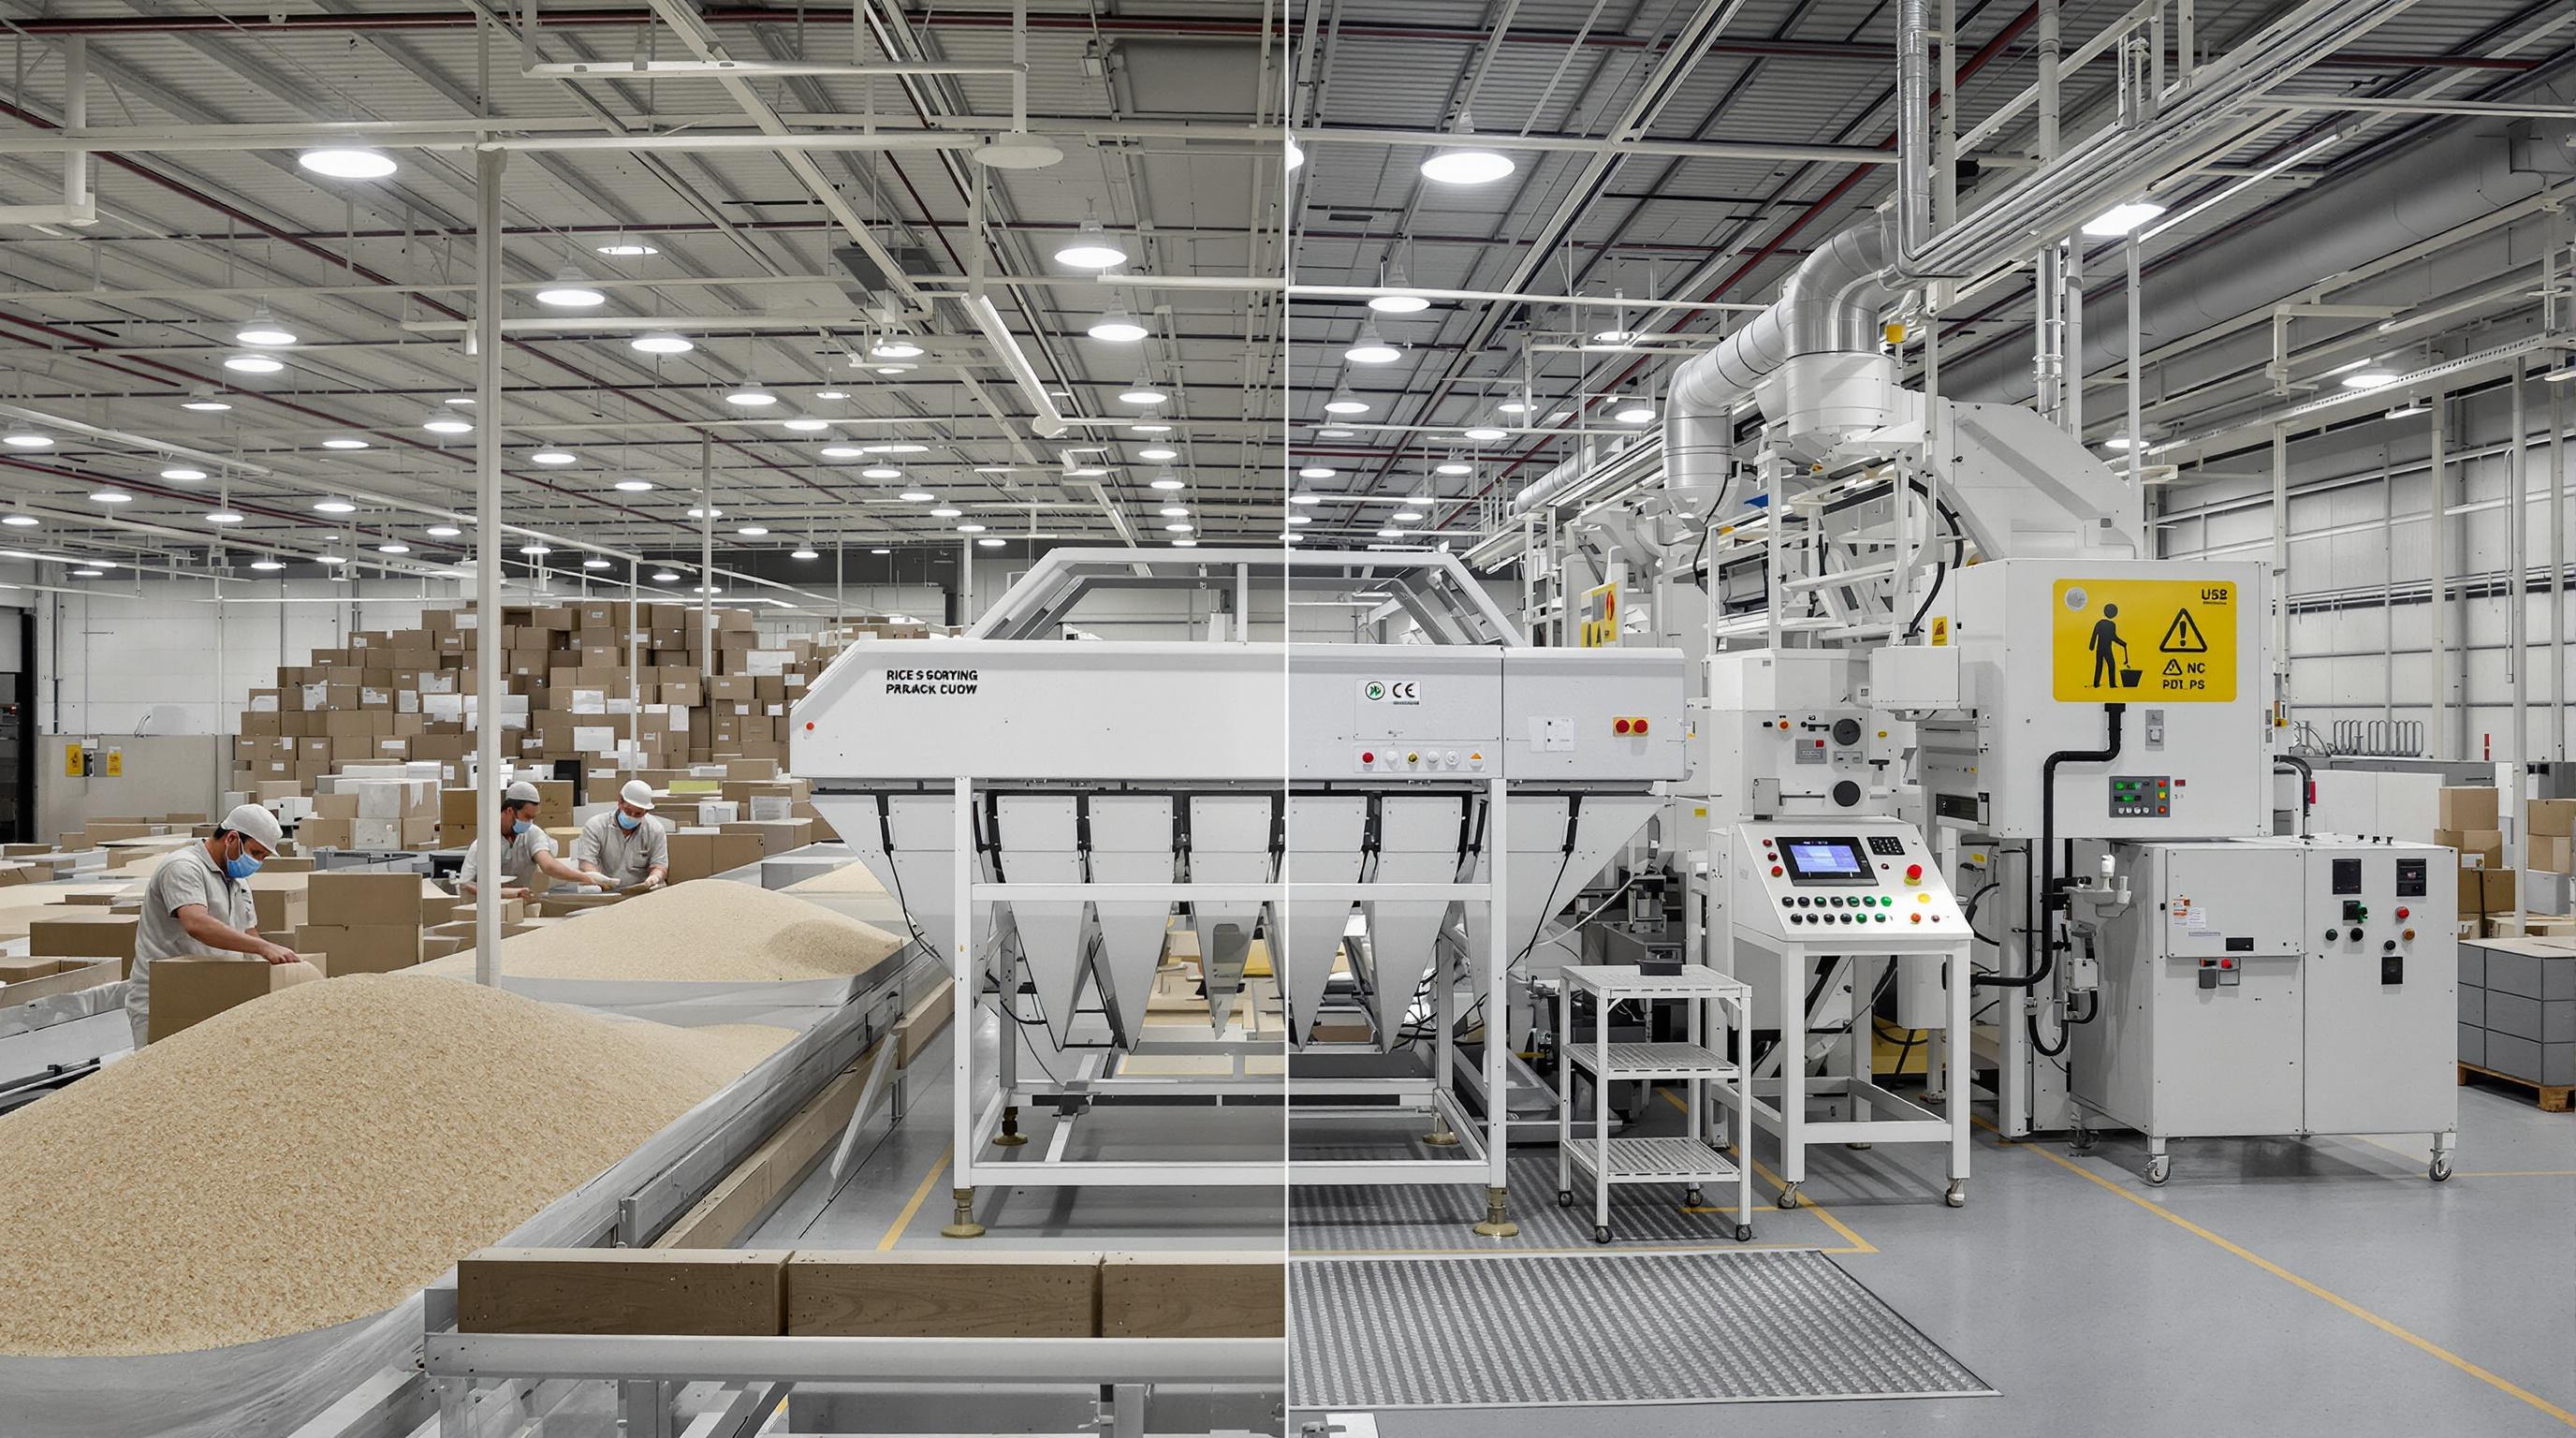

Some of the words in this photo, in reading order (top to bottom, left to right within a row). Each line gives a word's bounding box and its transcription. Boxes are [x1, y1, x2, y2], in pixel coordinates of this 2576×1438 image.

[2188, 662, 2205, 674] NC
[886, 669, 914, 681] RICE
[2189, 679, 2205, 690] PS
